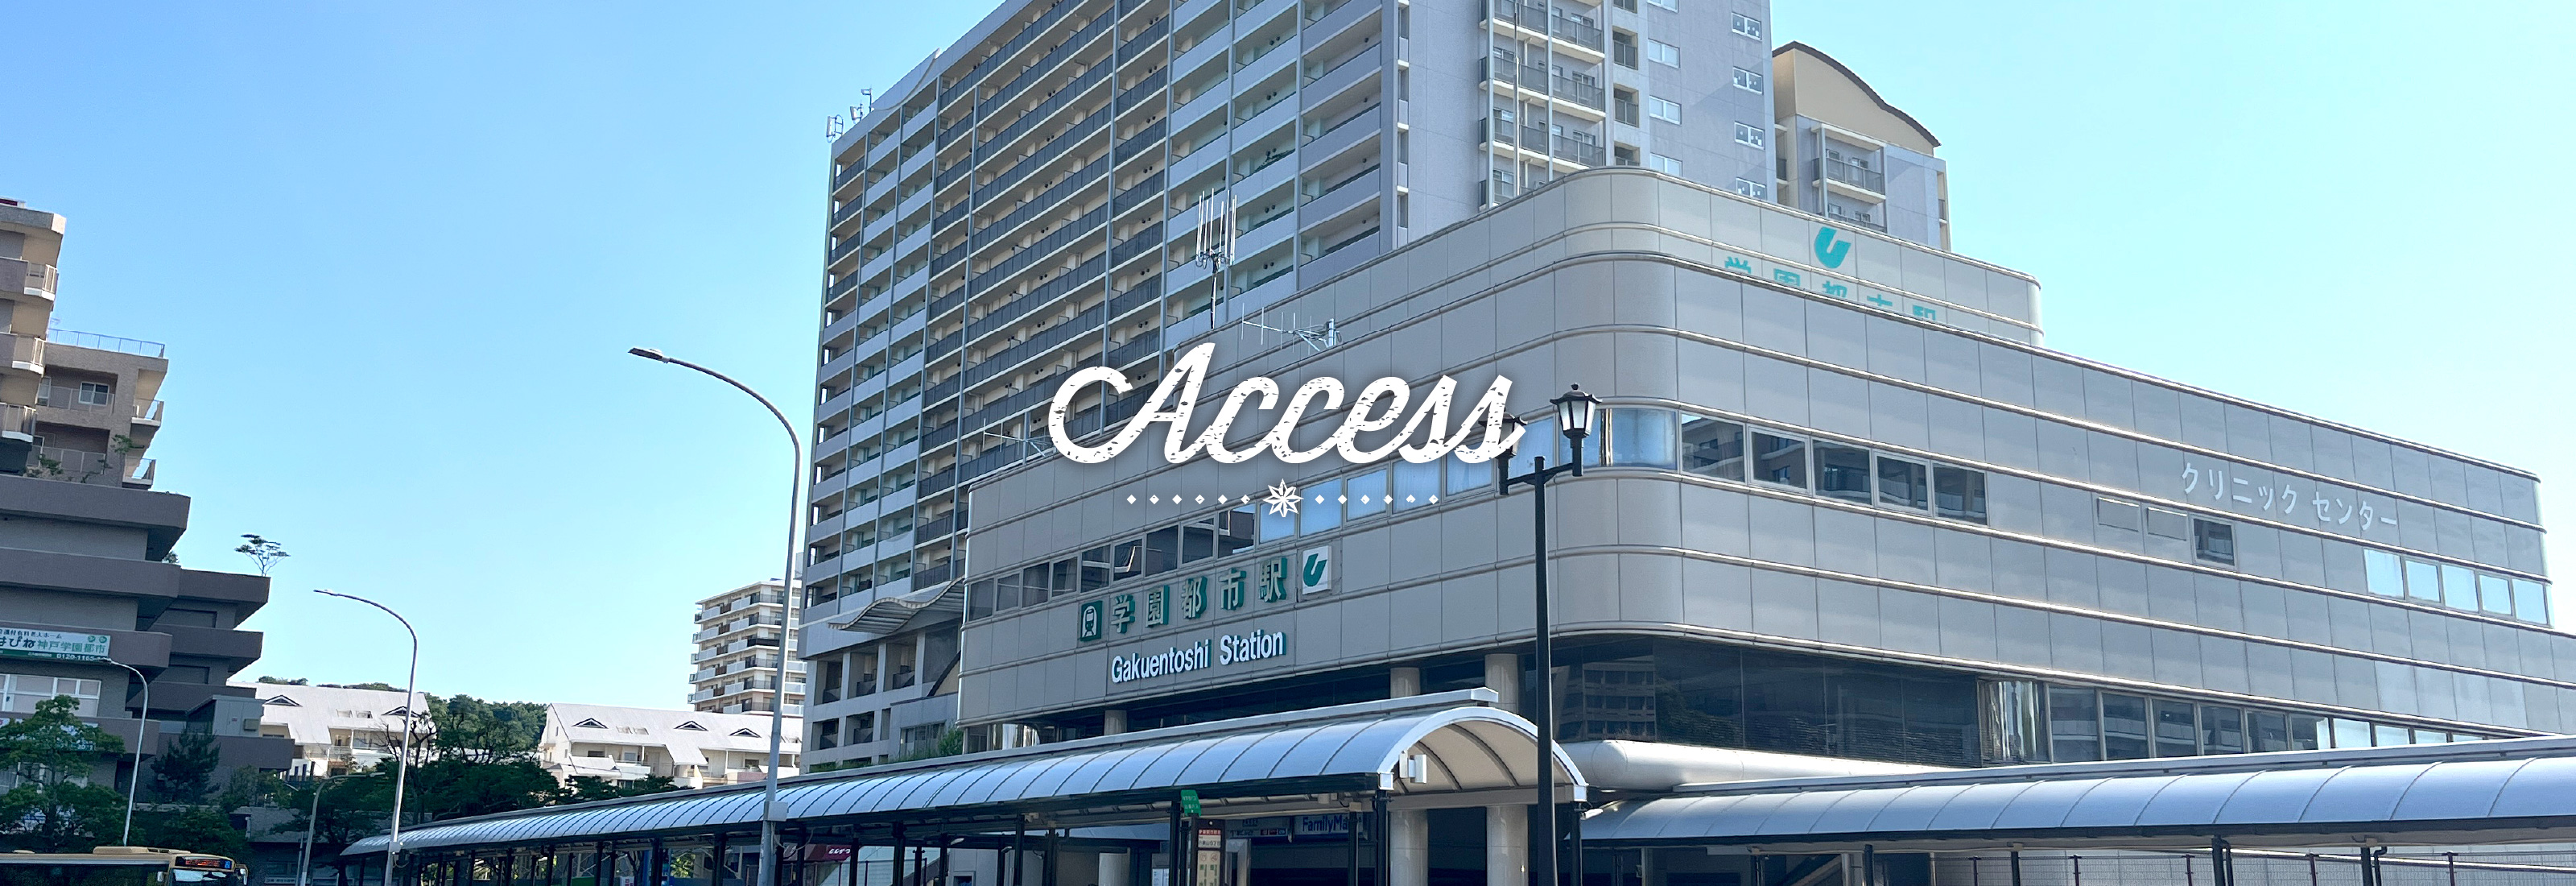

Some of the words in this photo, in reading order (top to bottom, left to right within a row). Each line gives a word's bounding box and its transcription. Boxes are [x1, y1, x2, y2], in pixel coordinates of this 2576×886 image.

[2182, 462, 2297, 514] クリニック
[2312, 491, 2398, 531] センター
[1110, 557, 1286, 634] 学園都市駅
[1111, 639, 1212, 683] Gakuentoshi
[1220, 629, 1286, 666] Station
[1302, 814, 1349, 833] FamilyMa
